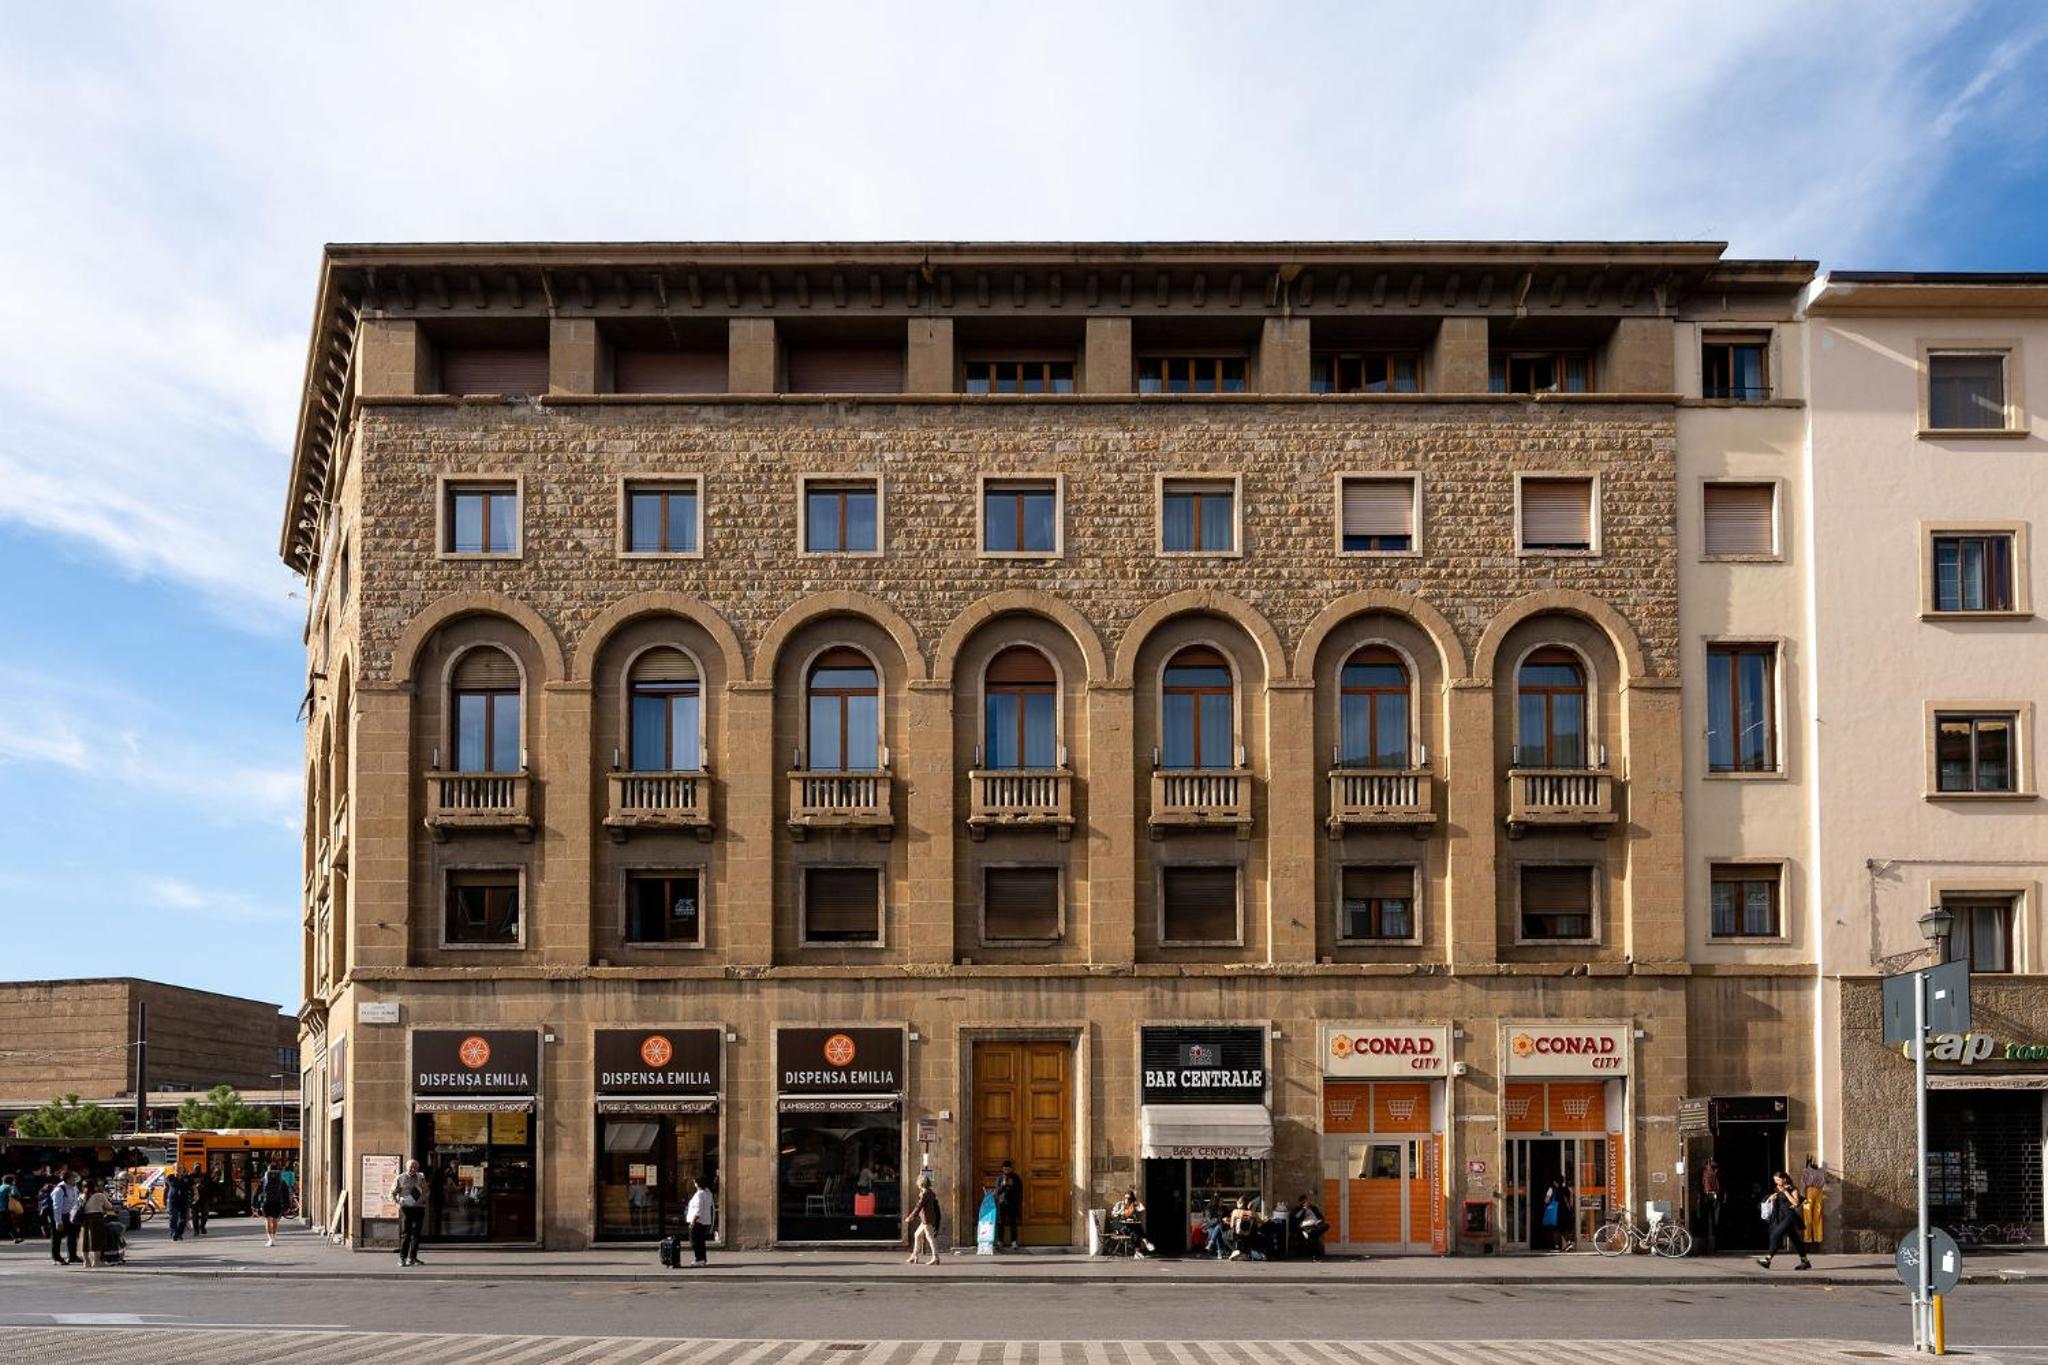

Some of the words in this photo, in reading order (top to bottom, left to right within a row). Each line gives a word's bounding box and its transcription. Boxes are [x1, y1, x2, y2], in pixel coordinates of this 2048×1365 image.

[1354, 1037, 1434, 1055] CONAD
[1535, 1036, 1614, 1054] CONAD
[1411, 1057, 1440, 1069] CITY
[1591, 1057, 1620, 1068] CITY
[419, 1073, 482, 1086] DISPENSA
[485, 1073, 529, 1086] EMILIA
[602, 1072, 665, 1085] DISPENSA
[667, 1072, 711, 1085] EMILIA
[785, 1071, 848, 1084] DISPENSA
[851, 1071, 894, 1084] EMILIA
[1145, 1070, 1177, 1087] BAR
[1180, 1070, 1262, 1087] CENTRALE
[829, 1102, 862, 1110] GNOCCO
[1173, 1147, 1193, 1156] BAR
[1198, 1147, 1249, 1156] CENTRALE
[1433, 1142, 1441, 1223] SUPERMARKET
[1609, 1139, 1617, 1218] UPERMARKET
